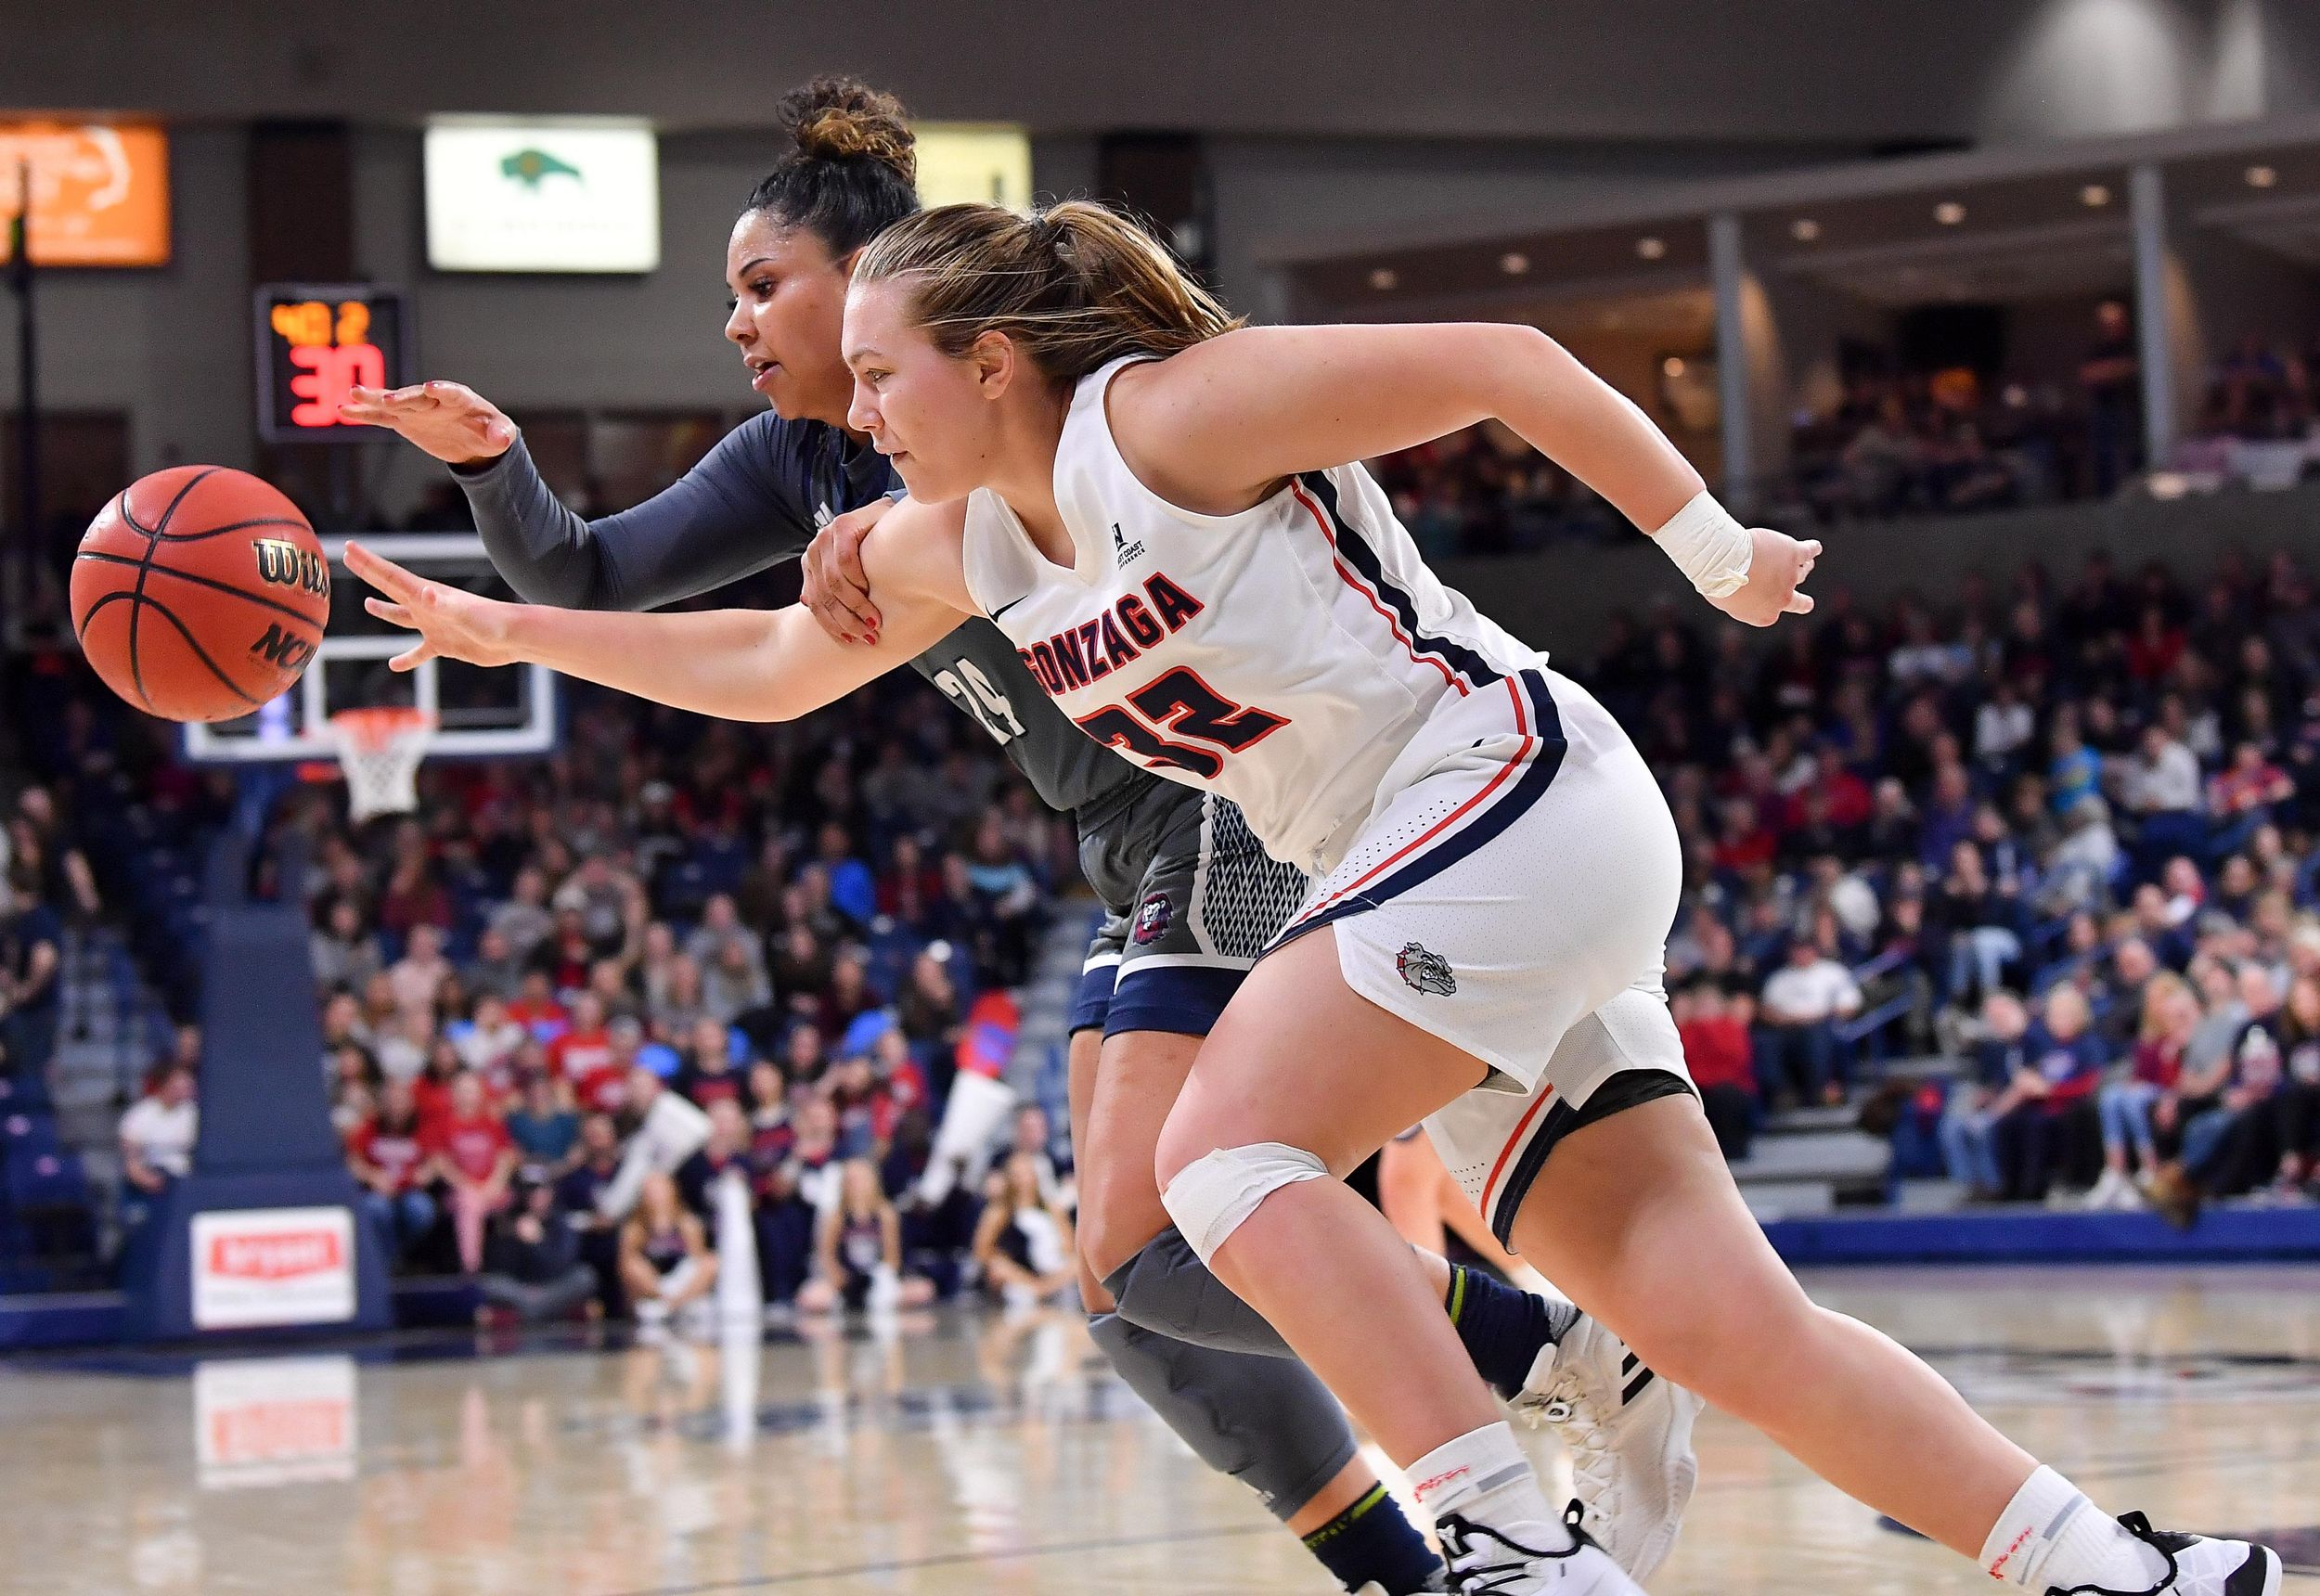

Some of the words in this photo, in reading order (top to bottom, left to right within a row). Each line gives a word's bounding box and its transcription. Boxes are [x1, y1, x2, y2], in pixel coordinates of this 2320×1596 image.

[290, 343, 385, 427] 30
[1124, 540, 1142, 558] COAST
[933, 657, 1026, 746] 24
[1073, 665, 1293, 779] 32
